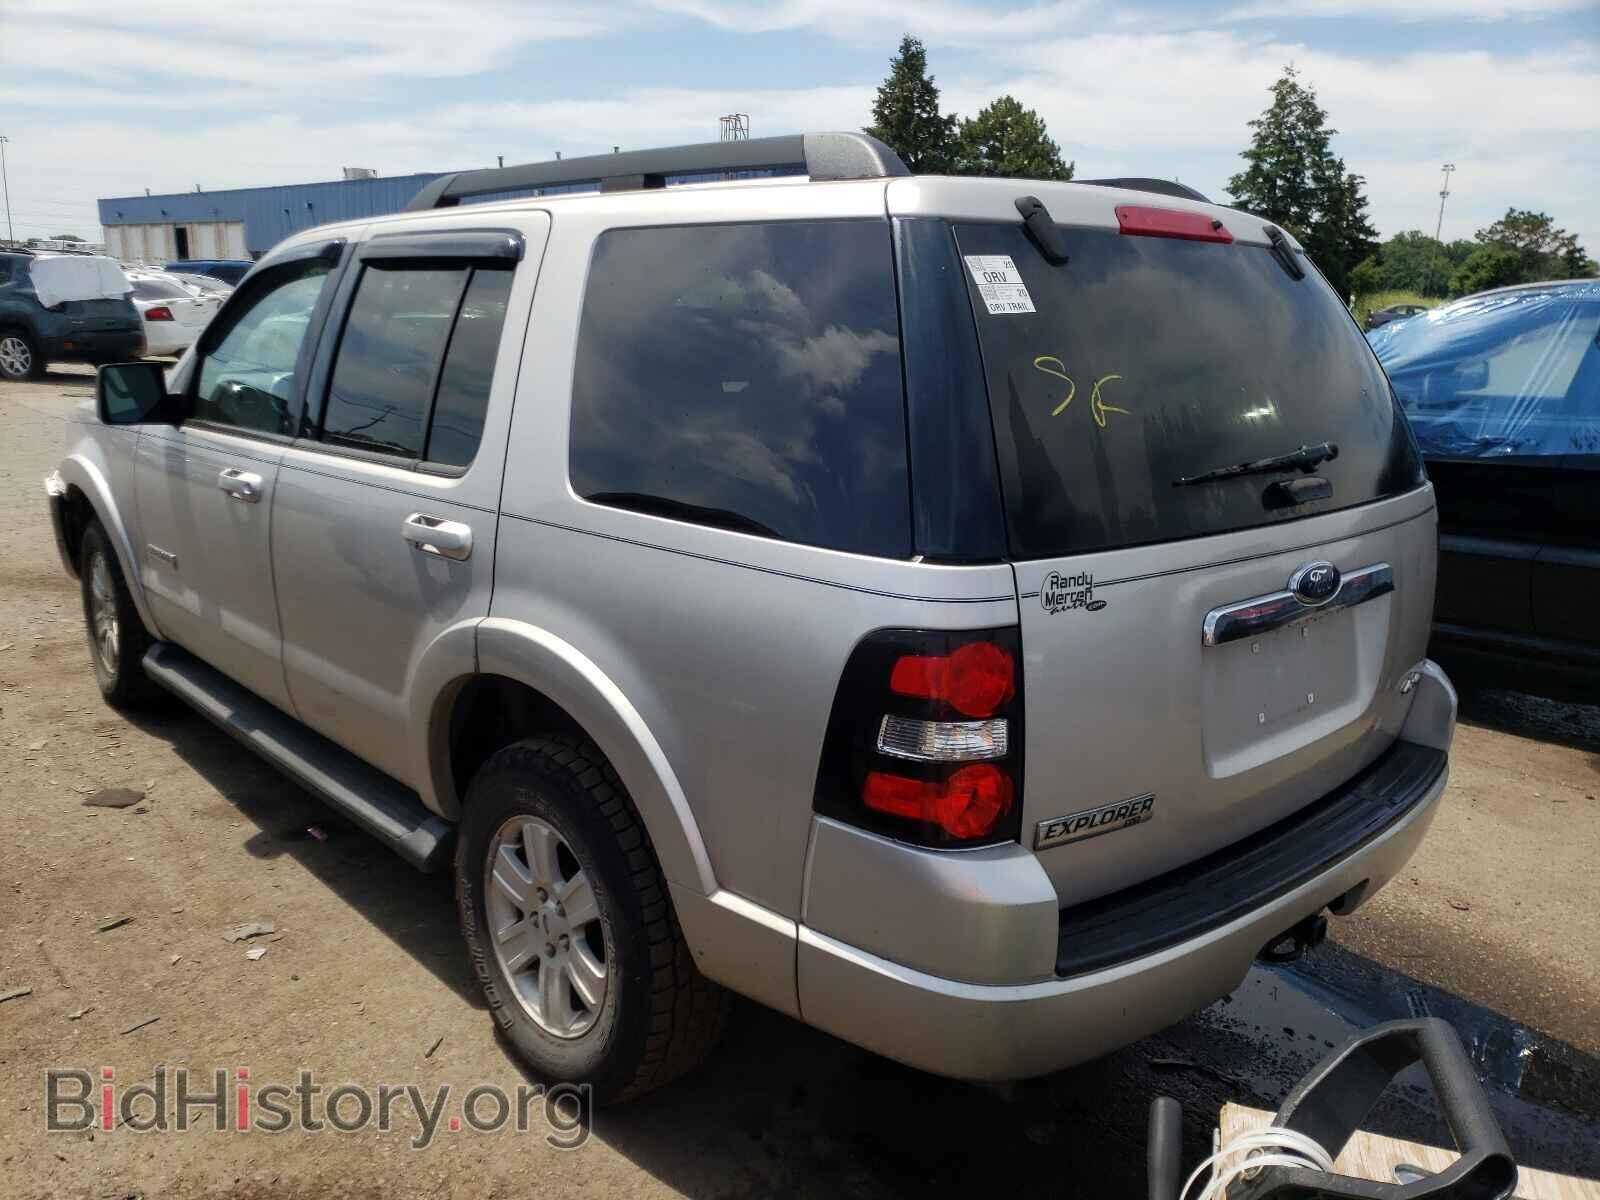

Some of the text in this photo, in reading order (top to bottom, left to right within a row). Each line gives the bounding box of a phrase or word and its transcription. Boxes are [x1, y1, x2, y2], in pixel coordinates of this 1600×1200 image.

[983, 271, 1007, 282] ORV
[989, 302, 1029, 312] ORV TRAIL
[1050, 571, 1093, 591] Randy
[1043, 797, 1154, 841] EXPLORER
